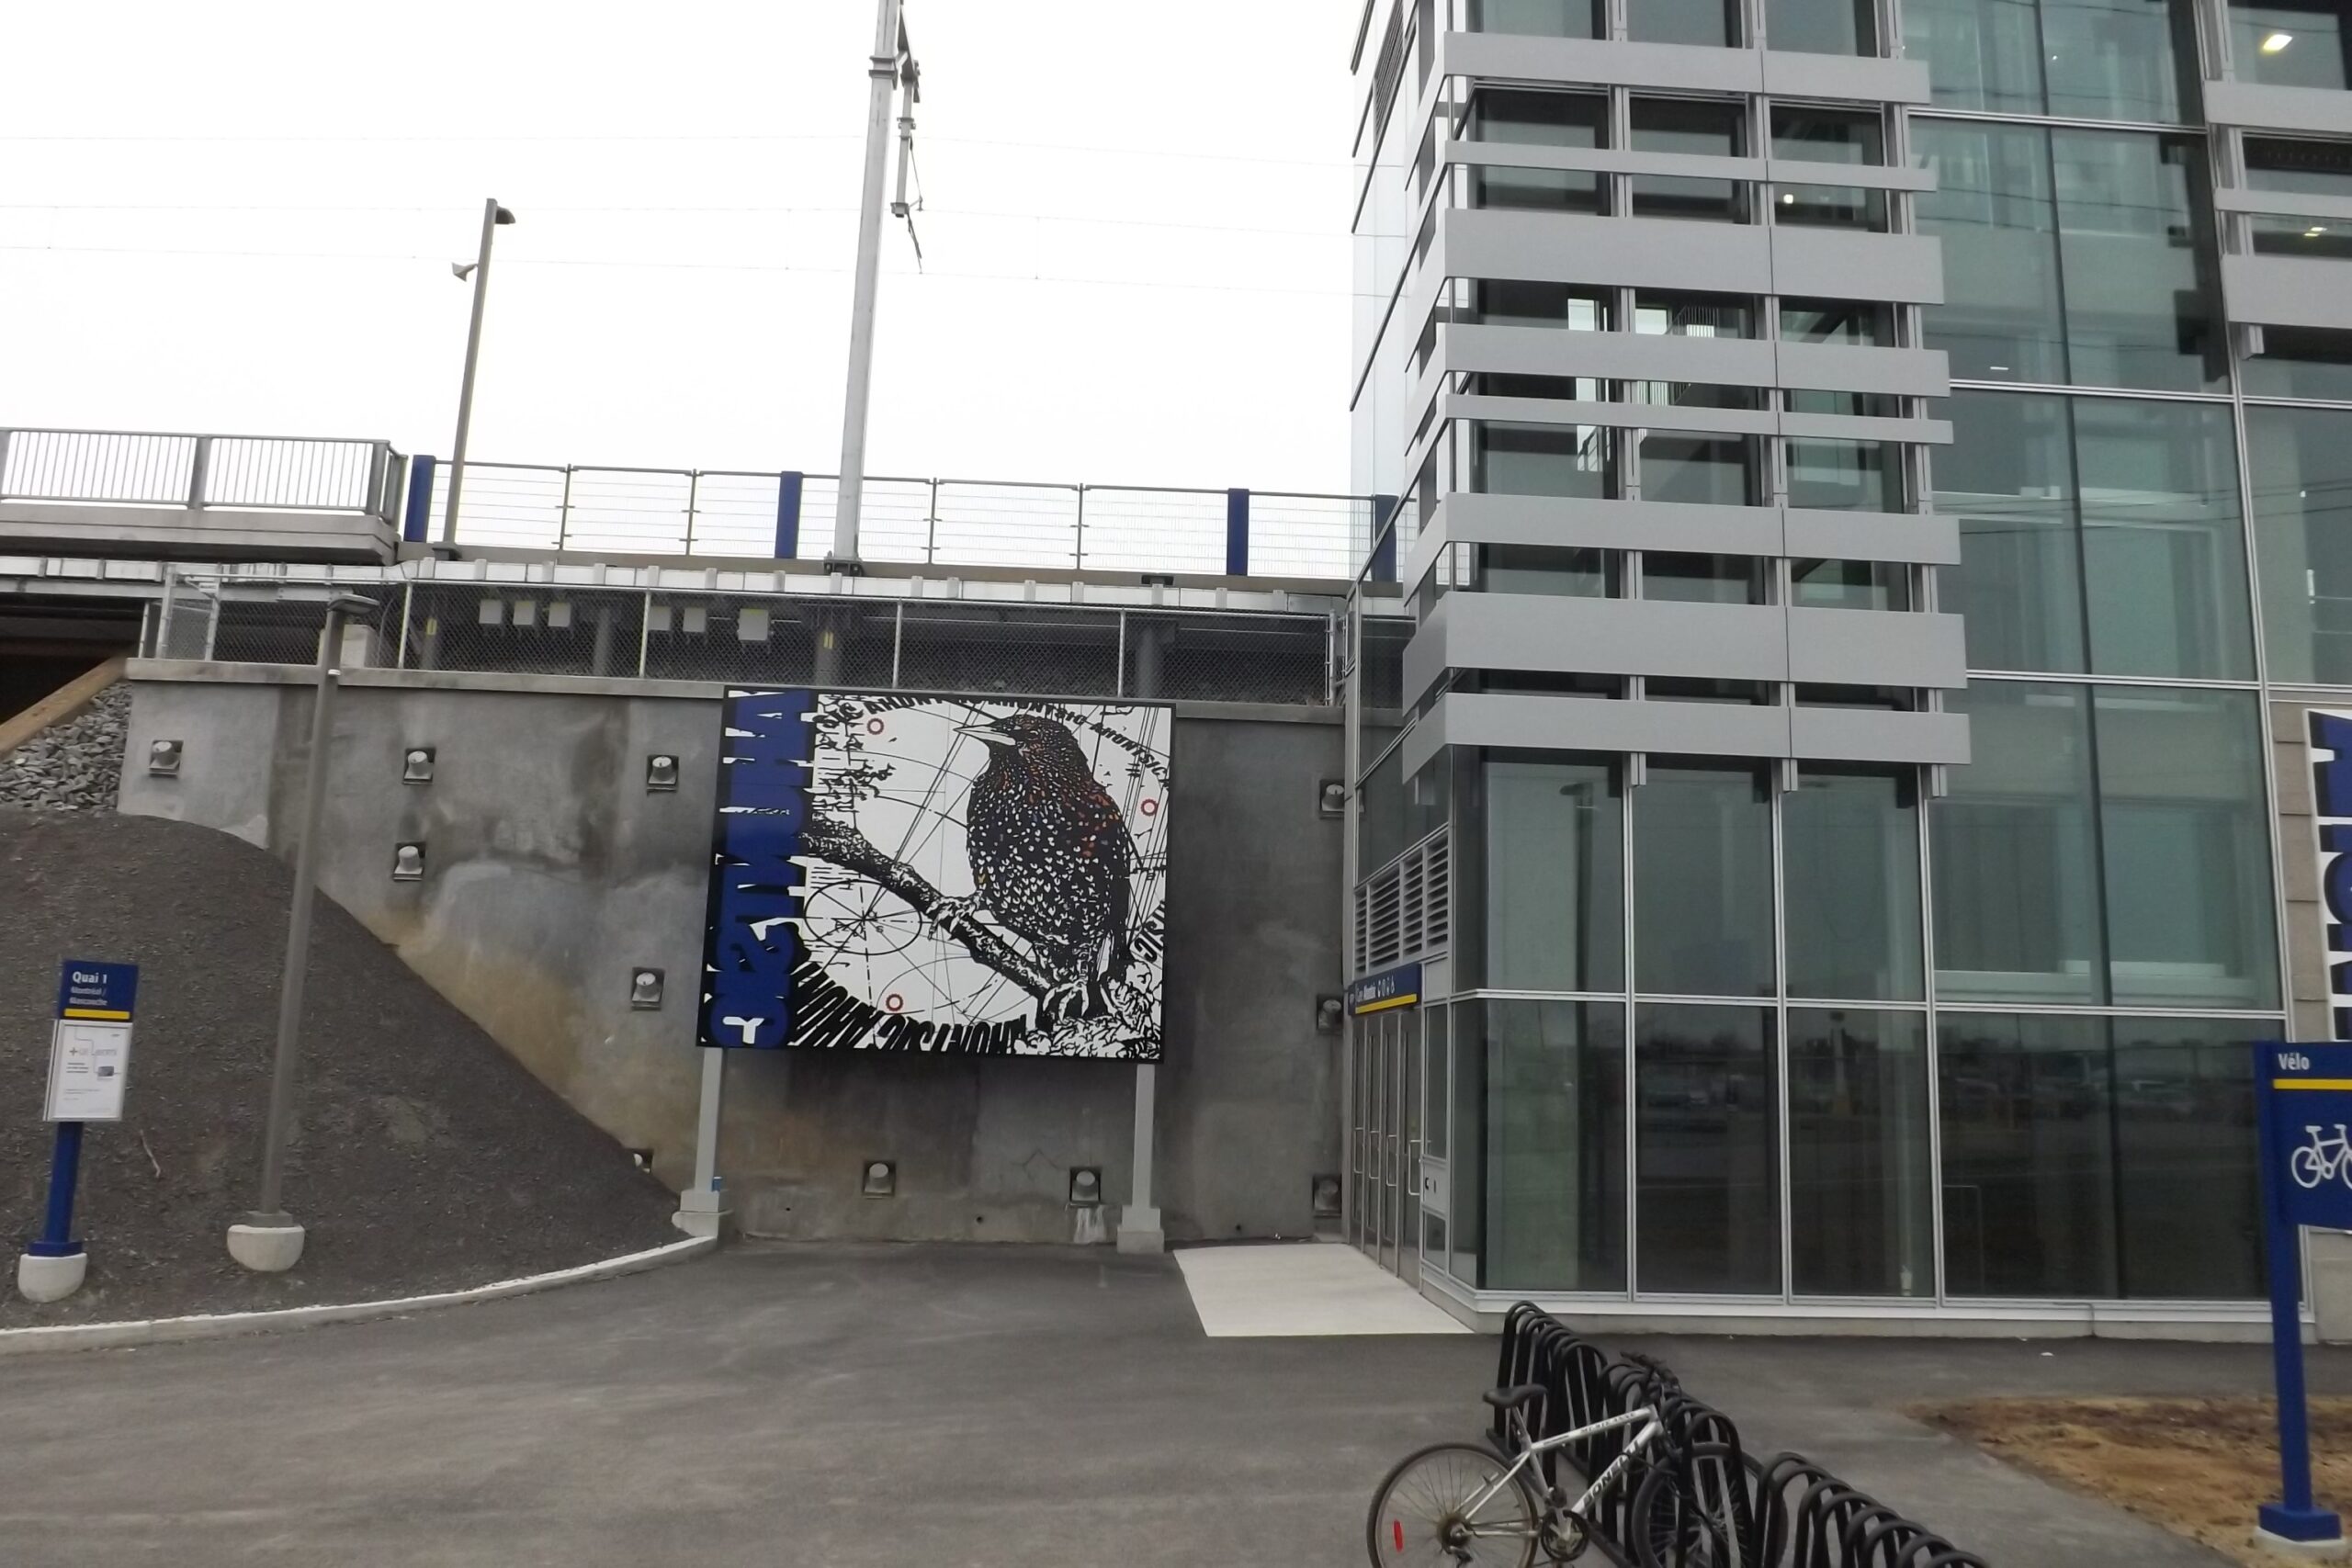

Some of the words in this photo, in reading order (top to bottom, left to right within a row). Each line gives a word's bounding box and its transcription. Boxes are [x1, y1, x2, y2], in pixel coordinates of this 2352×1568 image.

[73, 971, 99, 984] Quai
[102, 974, 107, 984] 1
[2278, 1052, 2310, 1070] Vélo
